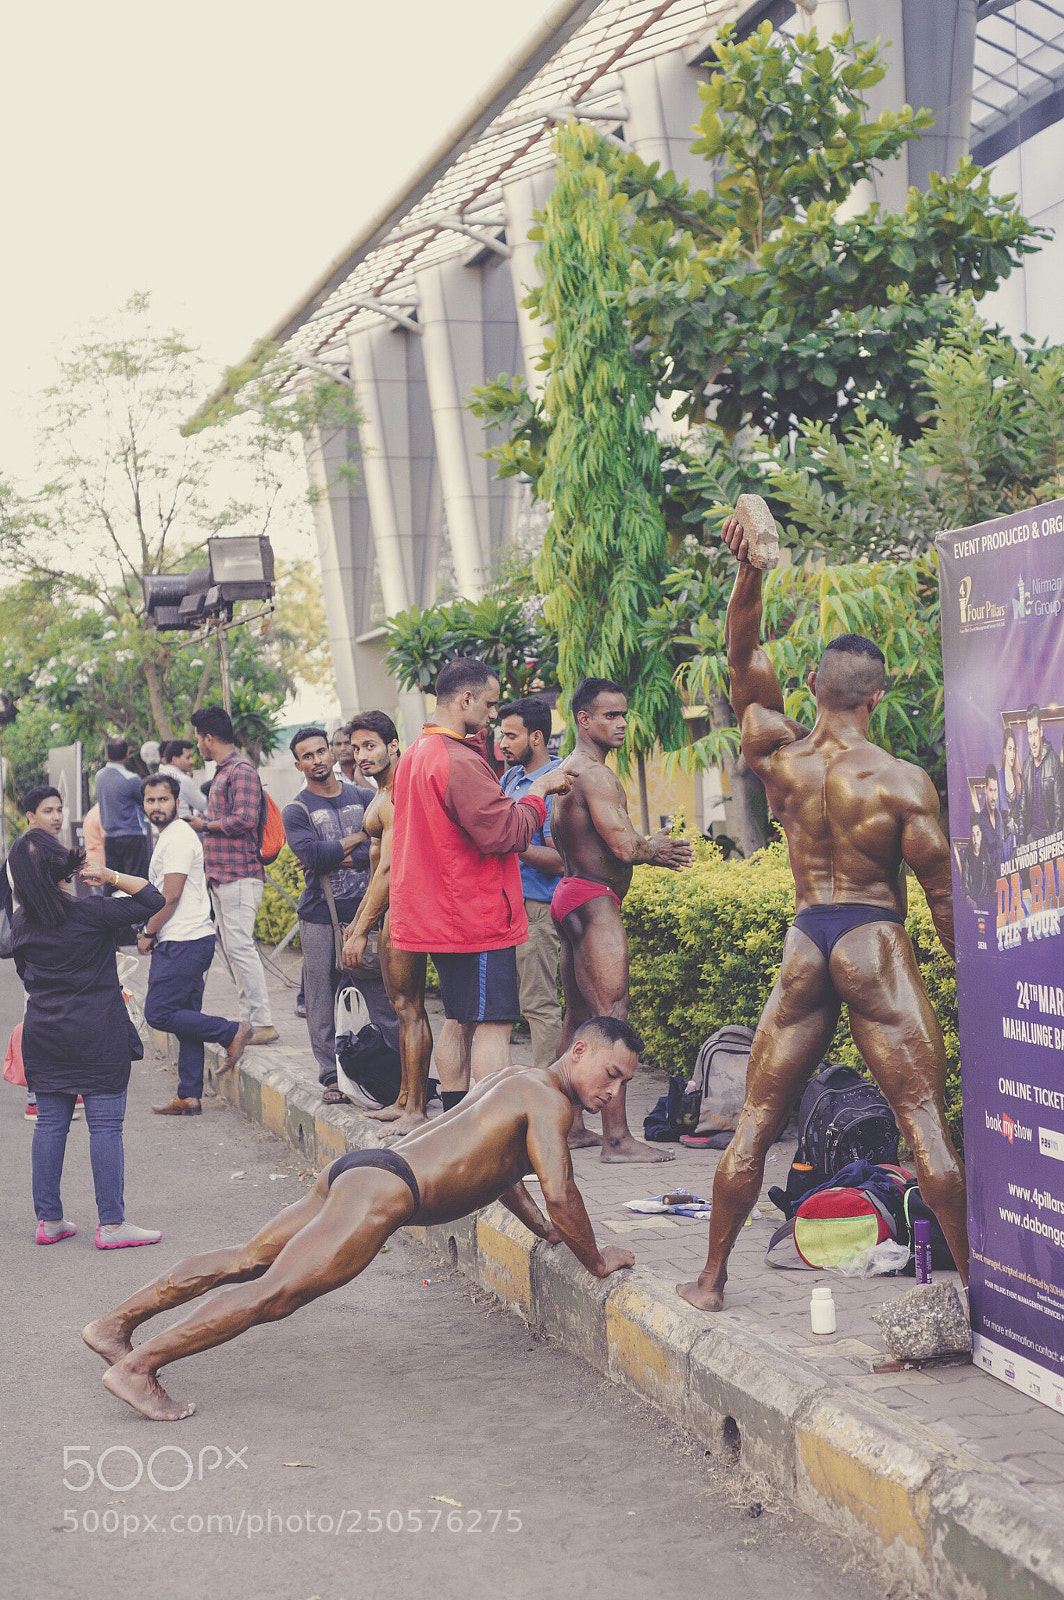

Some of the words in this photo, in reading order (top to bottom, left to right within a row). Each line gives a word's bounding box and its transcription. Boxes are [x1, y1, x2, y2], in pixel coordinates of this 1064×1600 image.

[954, 537, 980, 559] EVENT
[982, 524, 1030, 552] PRODUCED
[1031, 521, 1040, 539] &
[1042, 515, 1064, 536] ORG
[1032, 577, 1062, 595] Nirman
[967, 604, 985, 621] Four
[1035, 599, 1061, 616] Group
[1001, 850, 1038, 877] BOLLYWOOD
[996, 922, 1022, 951] THE
[1025, 909, 1061, 943] TOUR
[1003, 1016, 1054, 1049] MAHALUNGE
[999, 1077, 1032, 1102] ONLINE
[983, 1315, 991, 1328] For
[991, 1322, 1005, 1335] more
[1005, 1326, 1035, 1350] information
